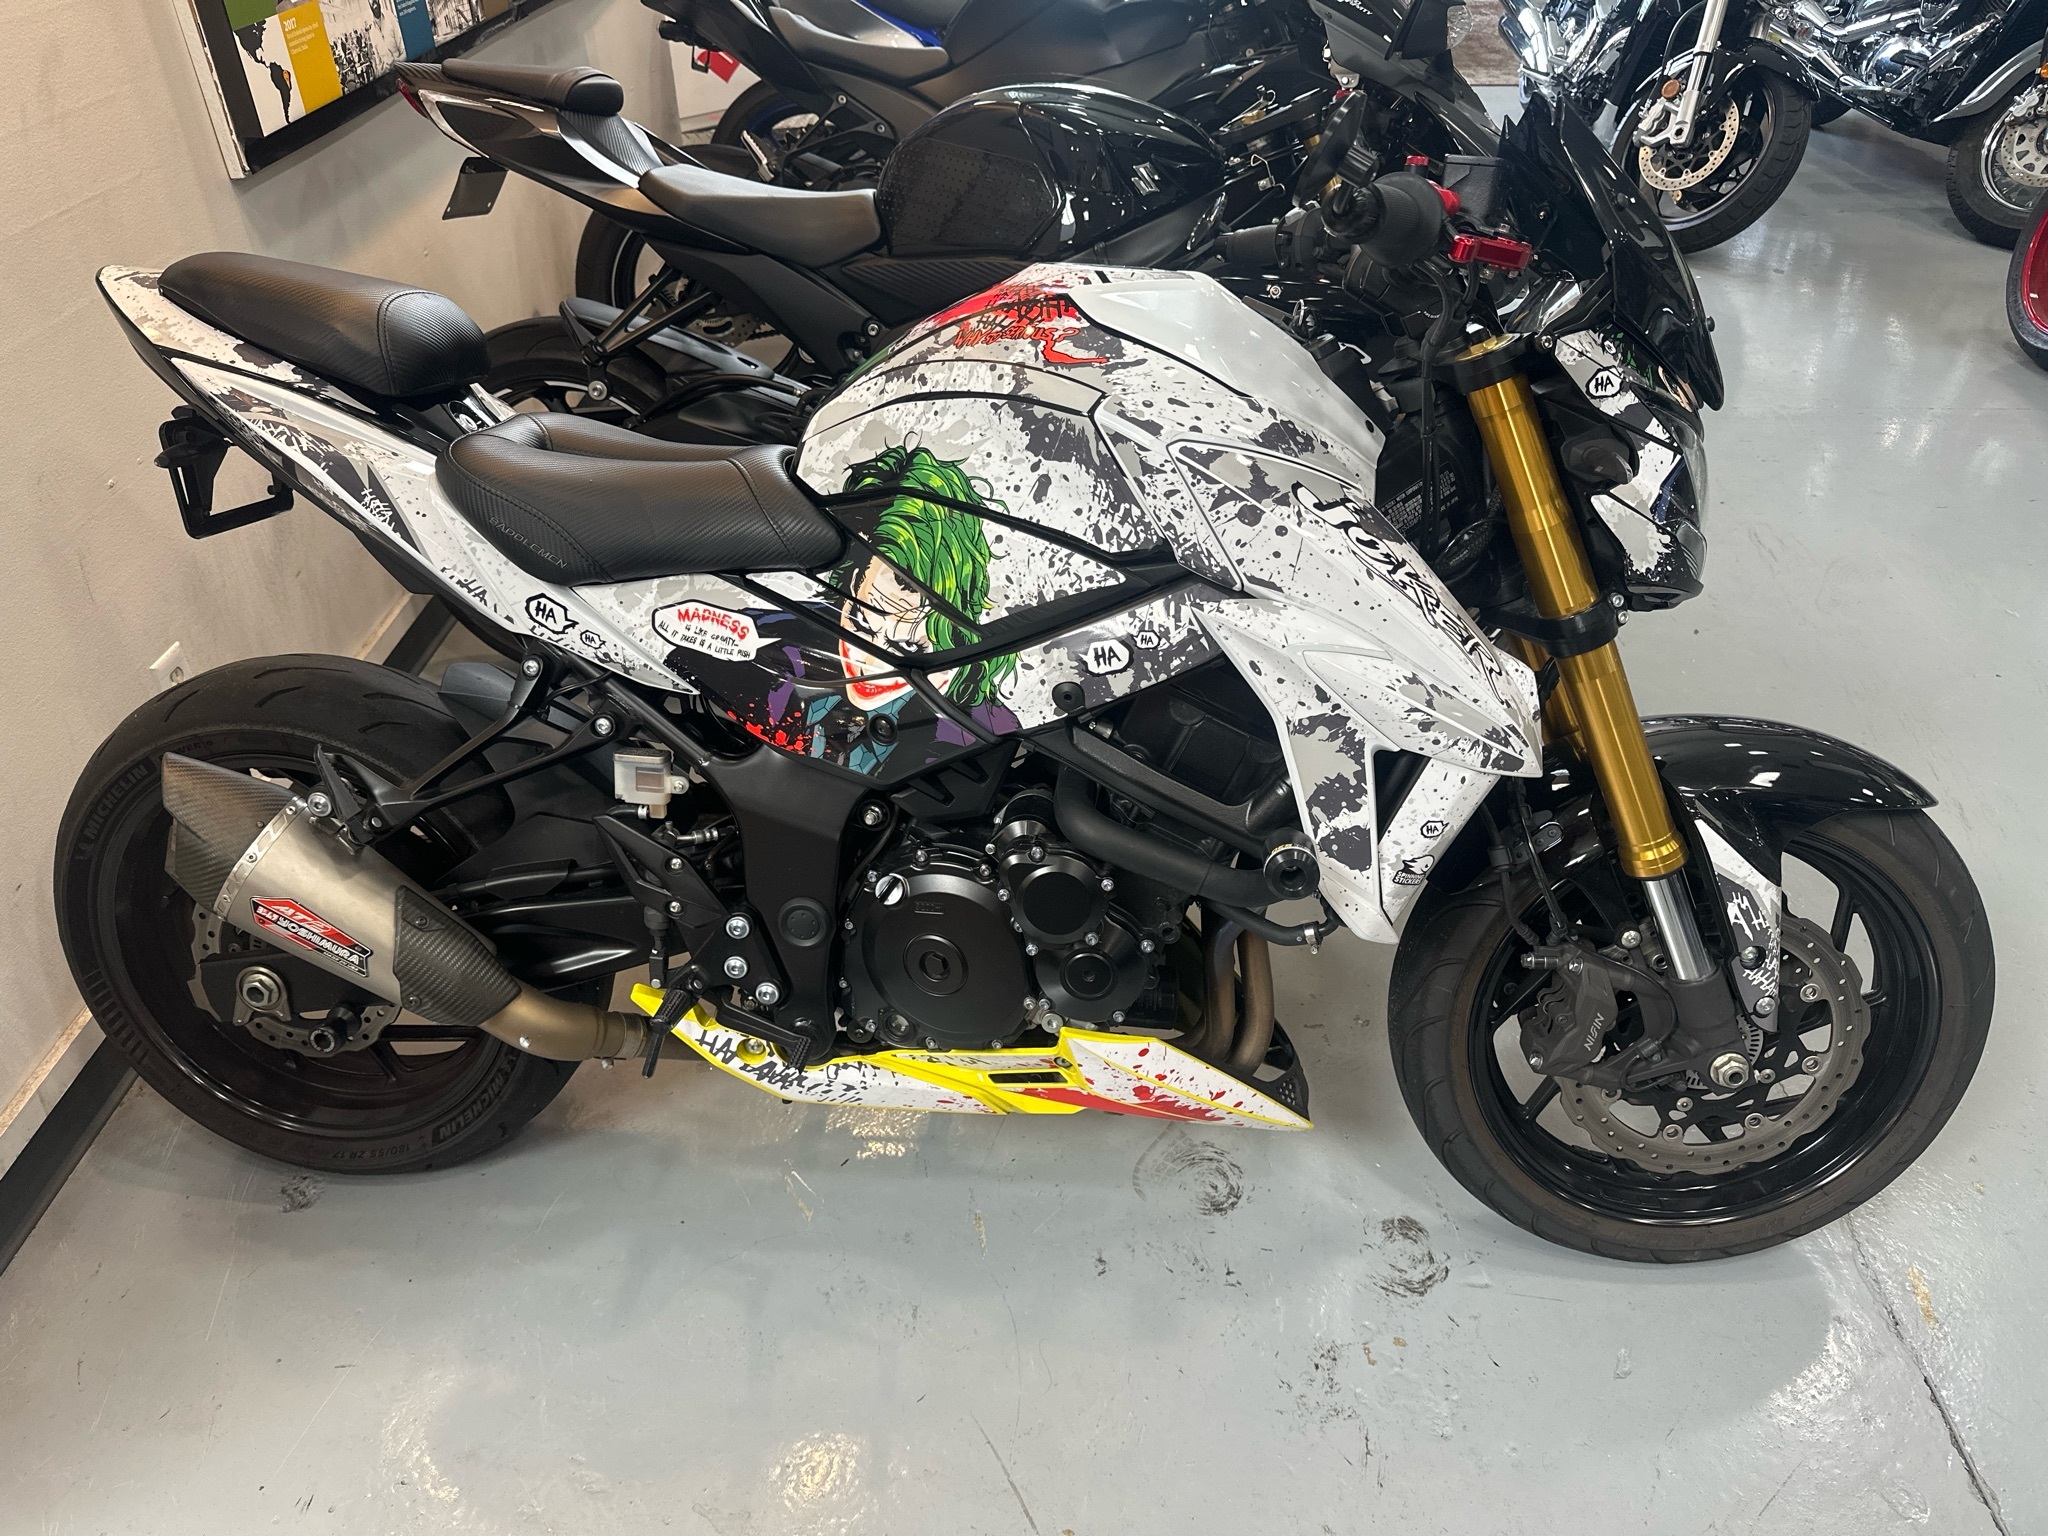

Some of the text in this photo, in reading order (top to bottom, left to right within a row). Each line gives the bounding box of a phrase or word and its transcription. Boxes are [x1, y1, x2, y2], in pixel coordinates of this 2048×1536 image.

[283, 17, 297, 32] 2017
[1593, 374, 1615, 394] HA
[489, 516, 568, 569] SADDLEMEN
[535, 600, 558, 625] HA
[677, 608, 750, 640] MADNESS
[584, 633, 596, 644] HA
[658, 620, 669, 633] ALL
[671, 630, 679, 638] IT
[680, 634, 698, 645] TAKES
[707, 643, 712, 651] A
[714, 646, 734, 656] LITTLE
[737, 649, 751, 659] PUSH
[1140, 634, 1154, 647] HA
[1093, 645, 1122, 669] HA
[83, 764, 149, 840] MICHELIN
[1426, 825, 1439, 835] HA
[277, 916, 360, 965] YOSHIMURA
[1584, 1012, 1605, 1051] NISSIN
[439, 1072, 505, 1140] MICHELIN
[332, 1143, 410, 1159] 180/55 ZR 17
